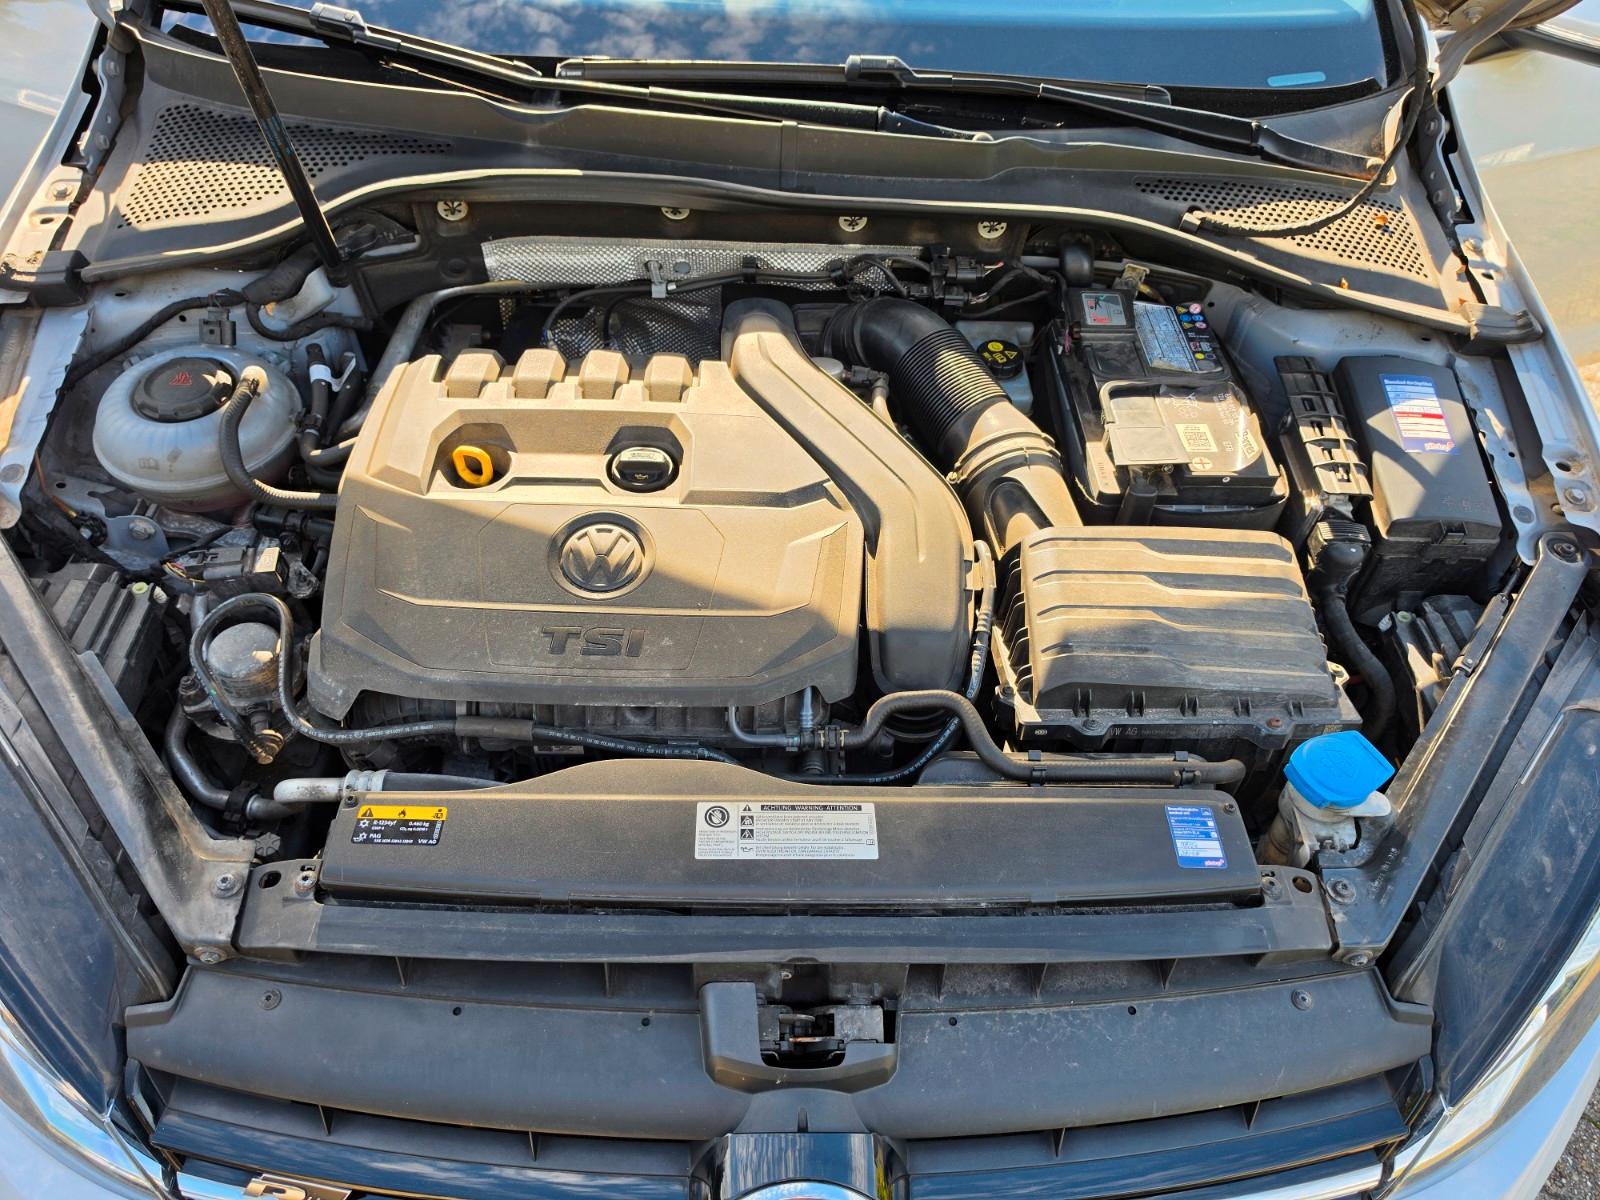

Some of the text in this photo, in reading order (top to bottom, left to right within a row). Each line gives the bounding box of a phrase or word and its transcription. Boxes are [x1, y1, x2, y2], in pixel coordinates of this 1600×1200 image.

[543, 626, 645, 657] TSI
[1110, 727, 1122, 736] VW
[1125, 727, 1138, 736] AG
